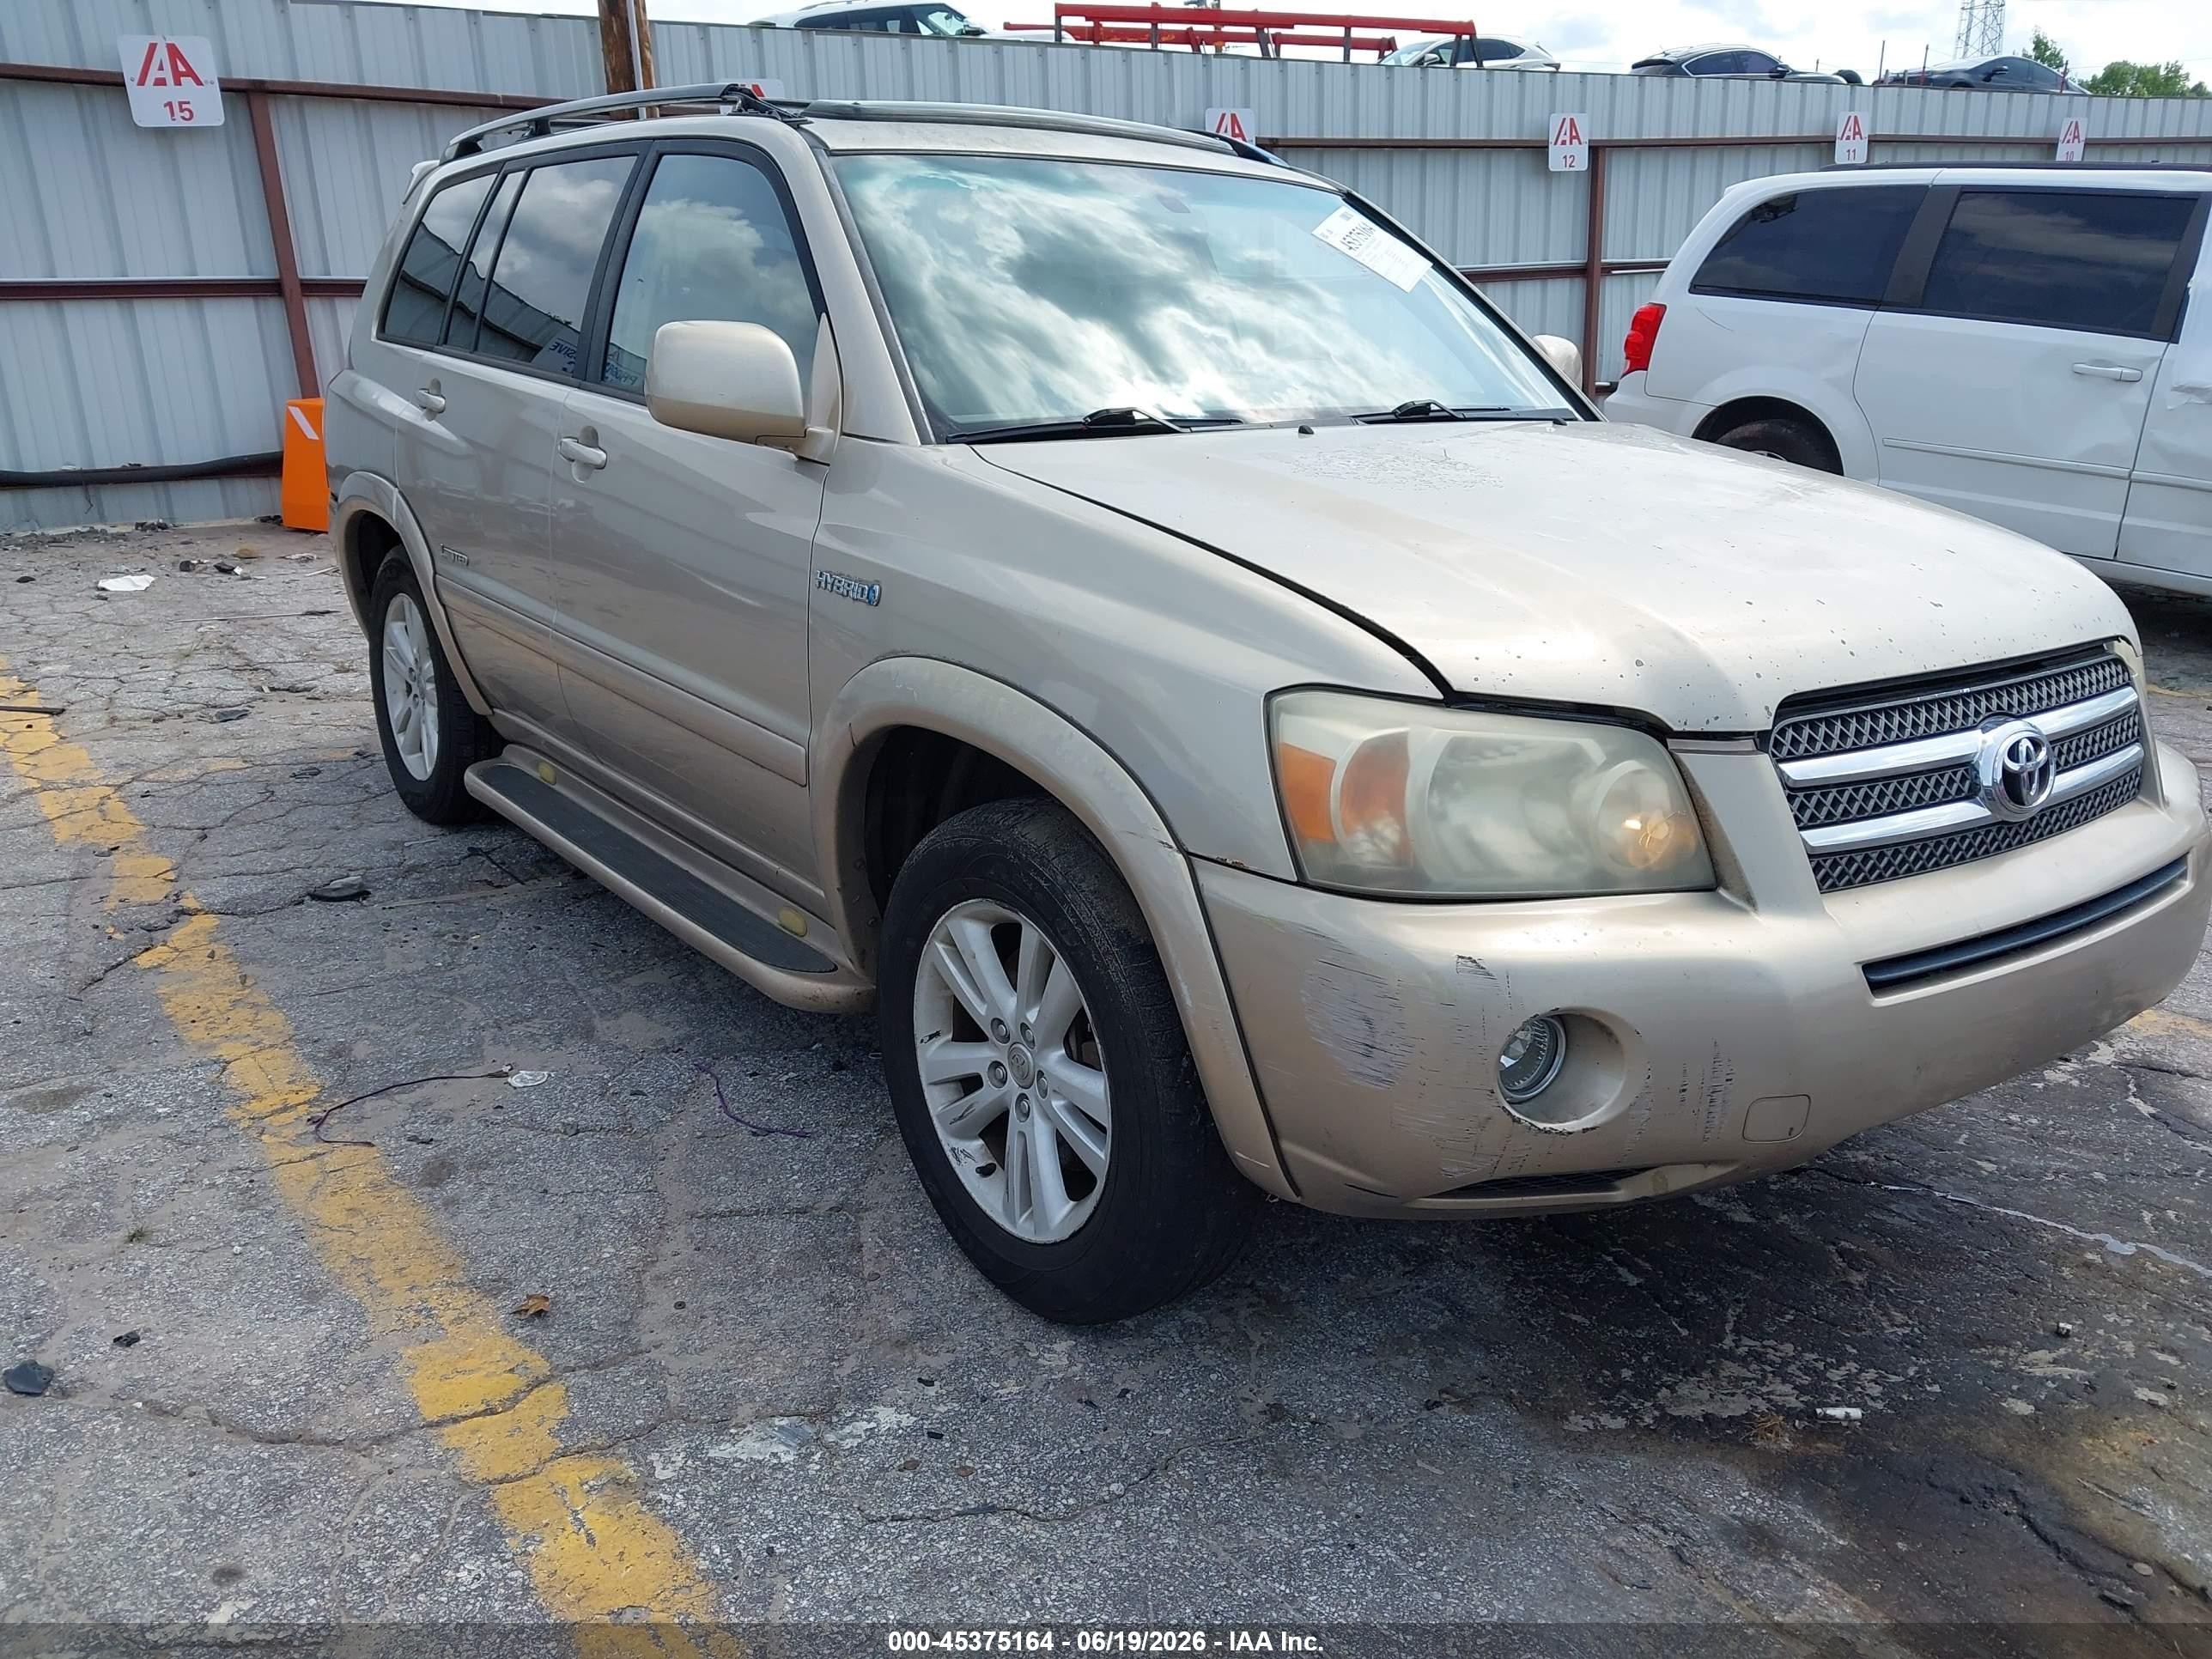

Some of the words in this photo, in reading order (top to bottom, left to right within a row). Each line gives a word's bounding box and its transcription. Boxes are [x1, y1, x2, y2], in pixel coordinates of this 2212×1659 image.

[164, 100, 194, 121] 15
[1562, 155, 1576, 168] 12
[1846, 149, 1856, 161] 11
[2066, 150, 2075, 161] 10
[816, 569, 869, 603] HYBRID
